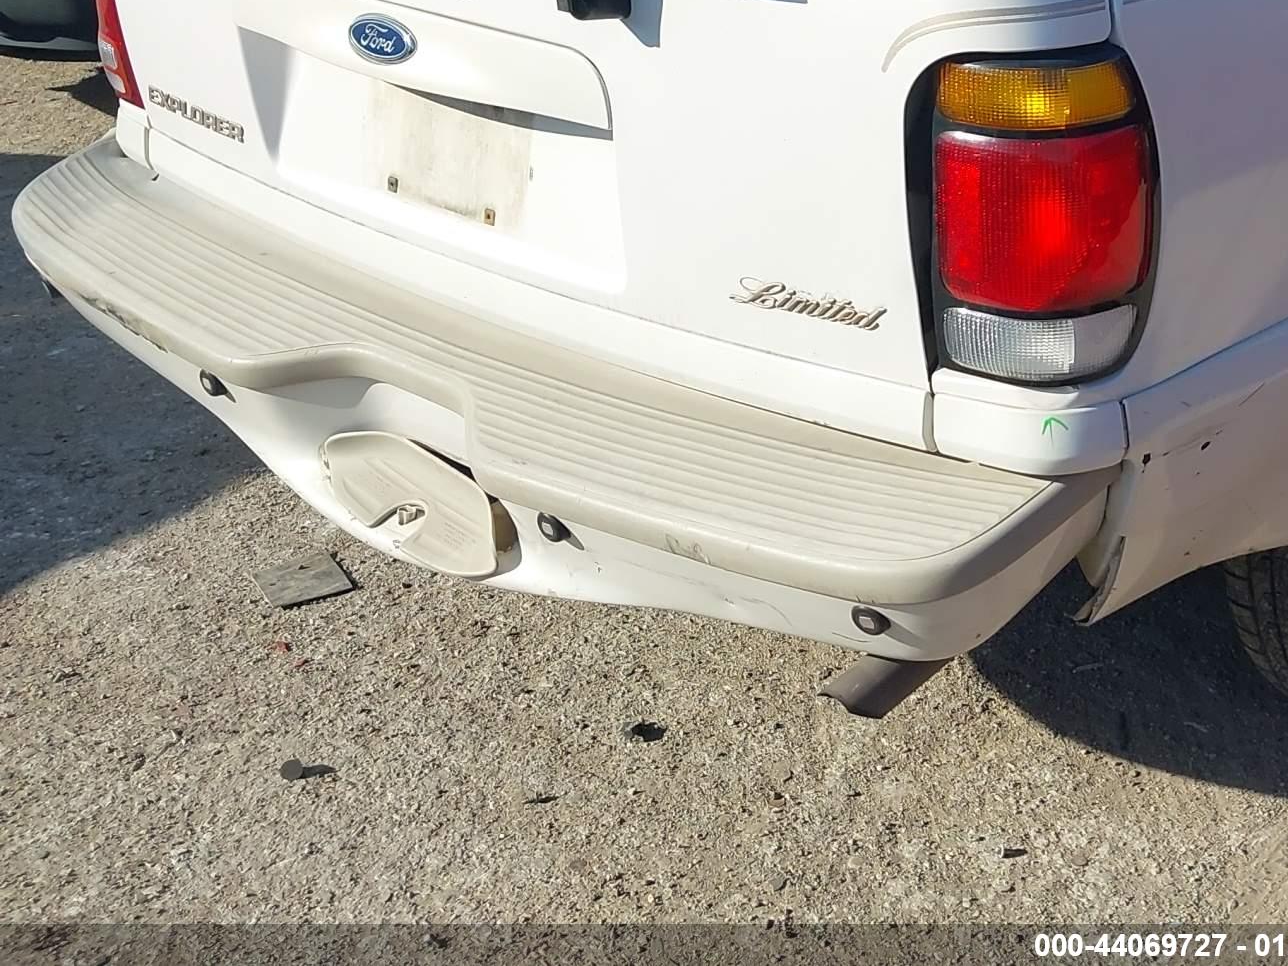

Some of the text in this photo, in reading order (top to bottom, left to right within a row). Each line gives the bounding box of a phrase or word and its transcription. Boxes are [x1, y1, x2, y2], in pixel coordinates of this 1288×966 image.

[360, 23, 397, 53] Ford
[148, 85, 245, 144] EXPLORER
[729, 276, 888, 331] Limited
